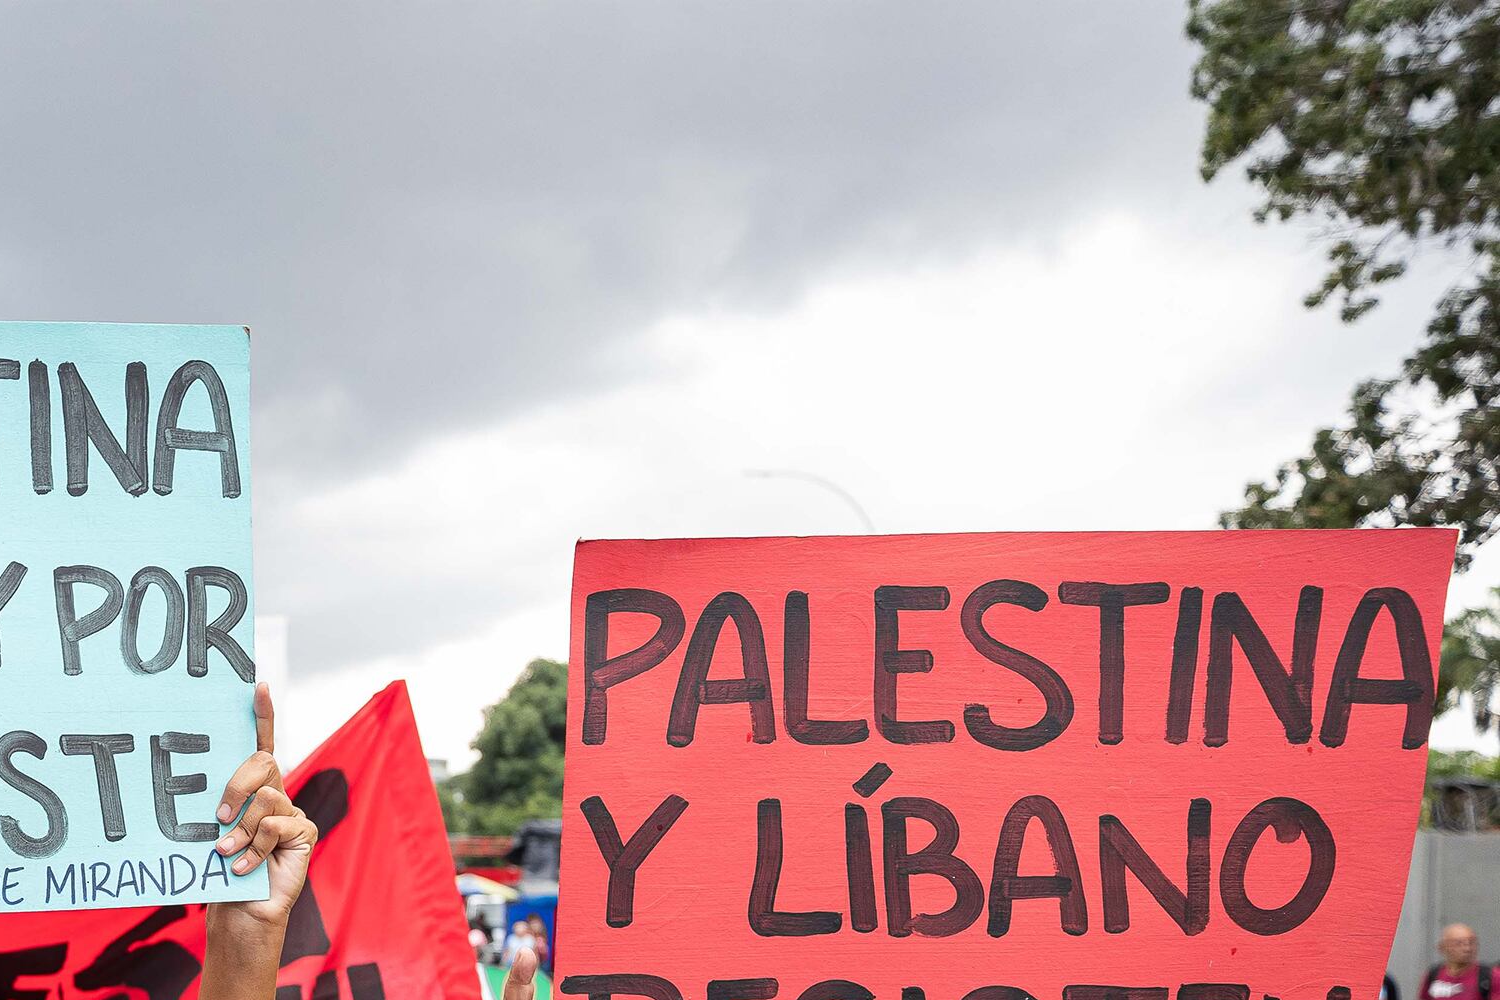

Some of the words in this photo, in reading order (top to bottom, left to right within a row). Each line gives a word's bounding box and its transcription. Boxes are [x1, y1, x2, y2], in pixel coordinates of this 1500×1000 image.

[54, 563, 256, 684] POR
[582, 579, 1435, 751] PALESTINA
[44, 848, 229, 904] MIRANDA
[580, 795, 689, 927] Y
[748, 762, 1337, 937] LÍBANO
